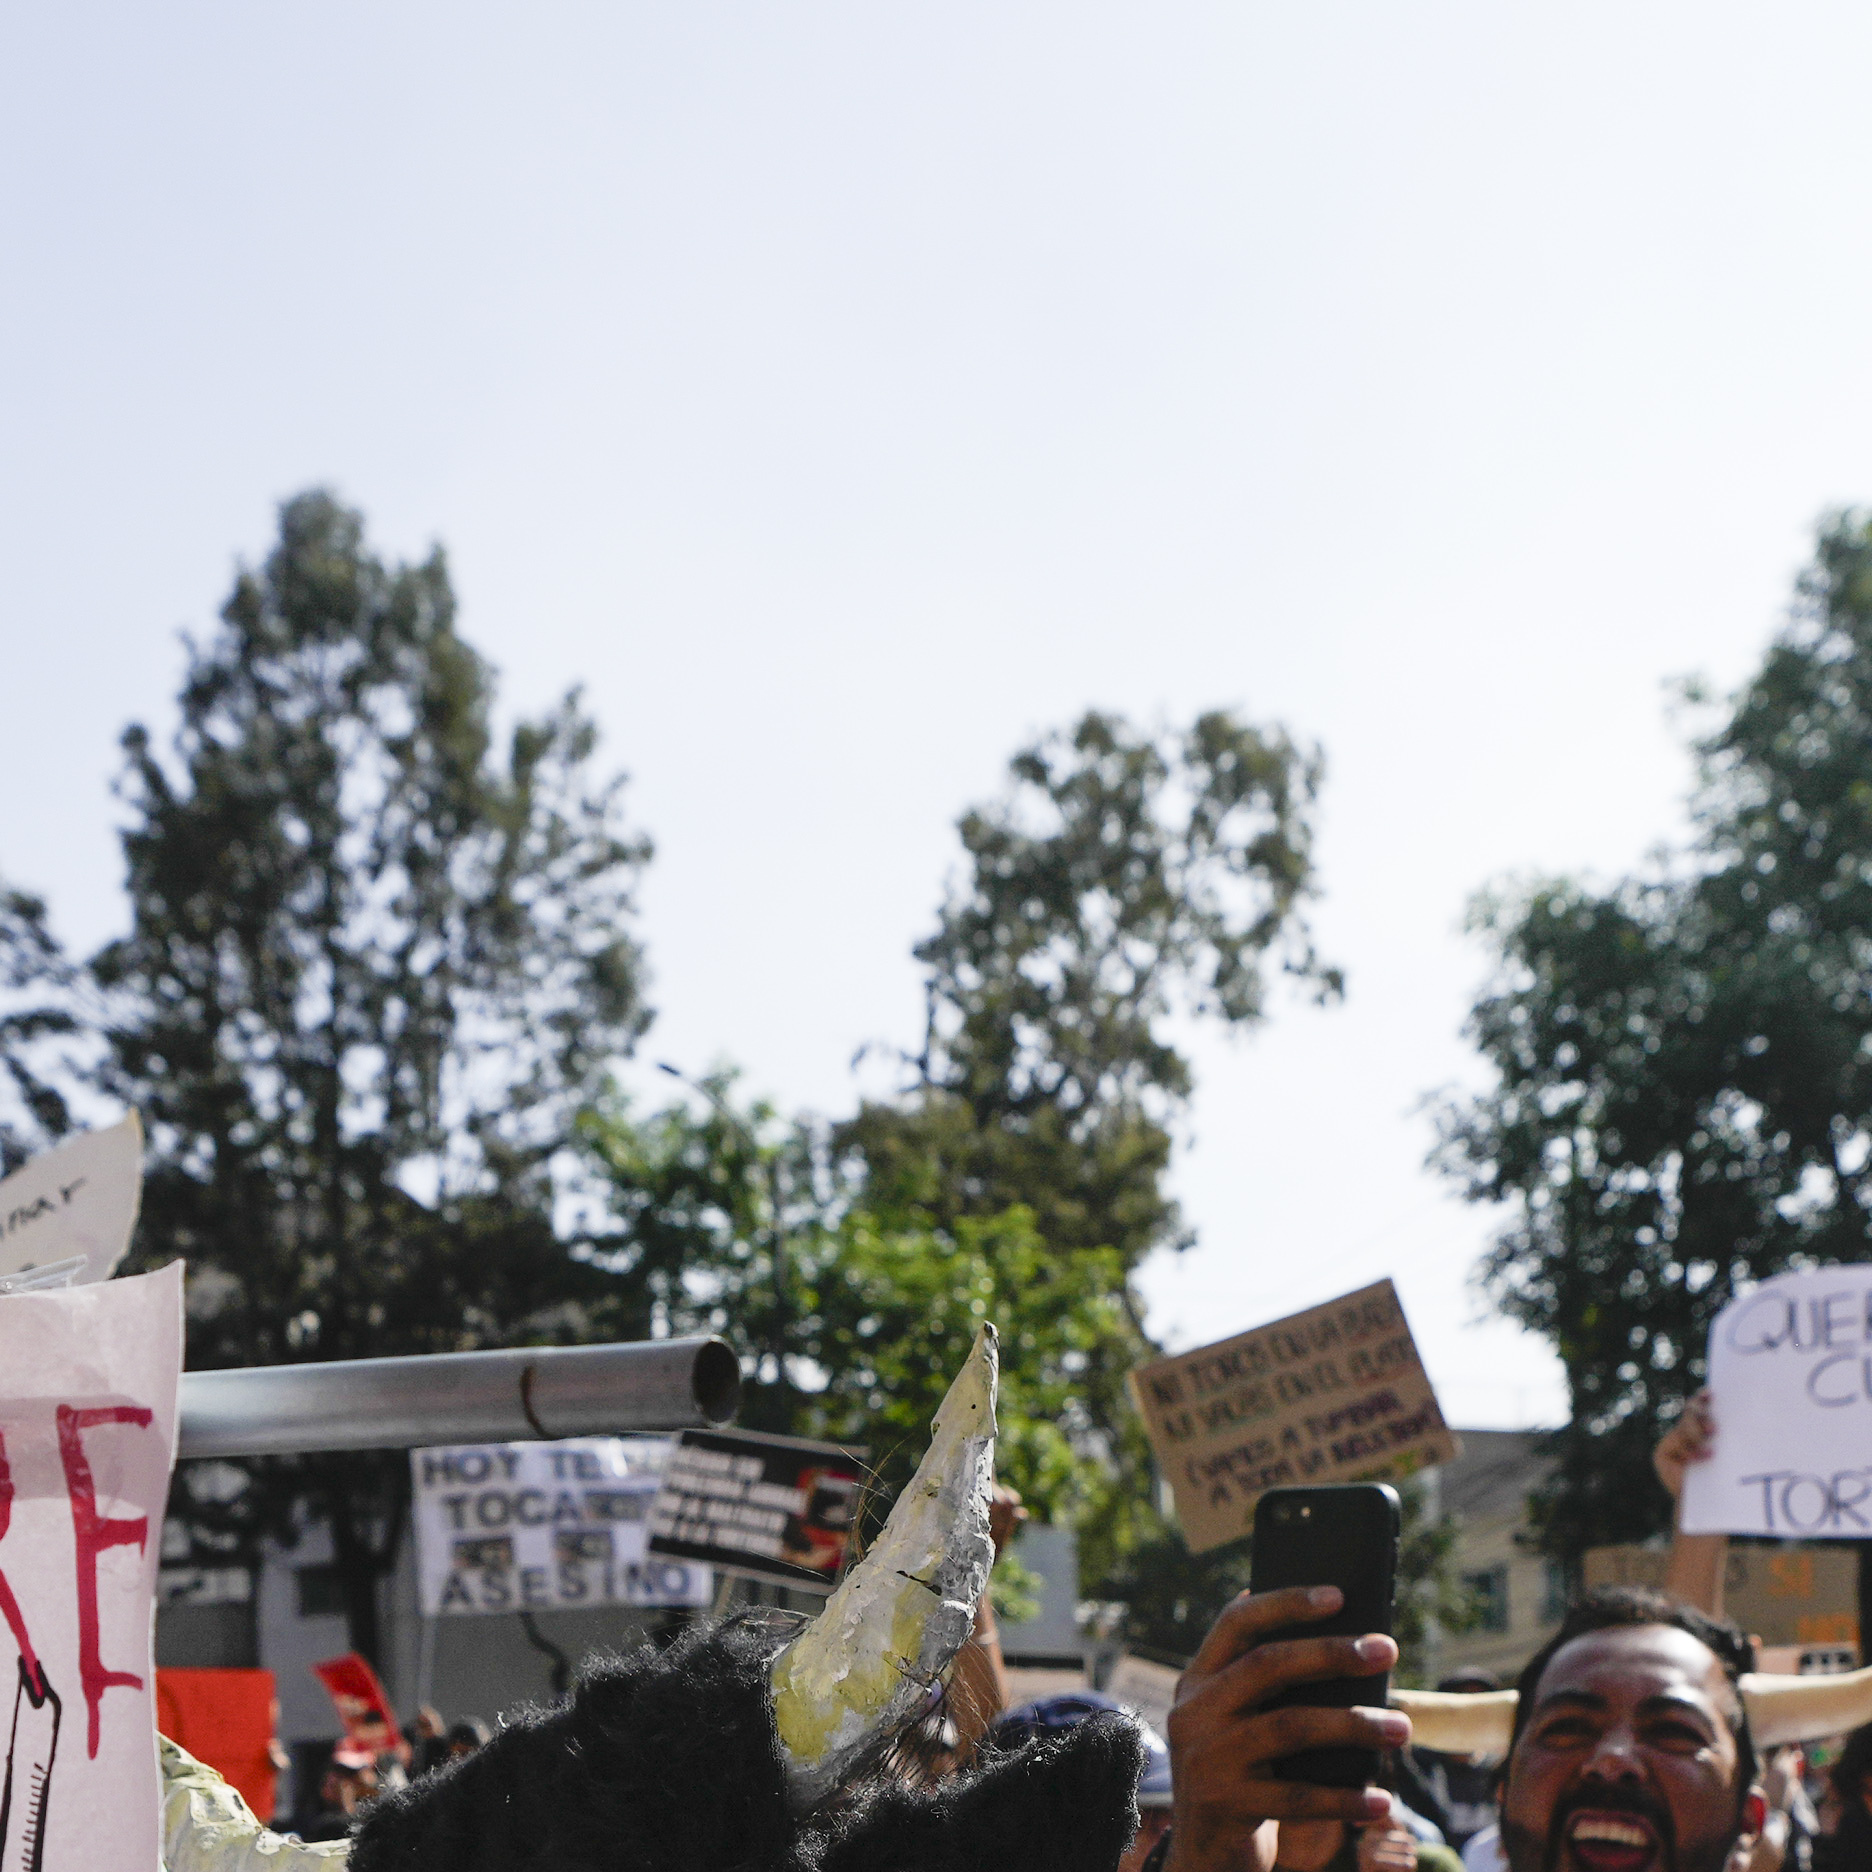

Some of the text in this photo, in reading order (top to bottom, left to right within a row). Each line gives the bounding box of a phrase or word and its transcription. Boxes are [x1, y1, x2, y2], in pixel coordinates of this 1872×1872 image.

[422, 1448, 520, 1487] HOY
[440, 1489, 582, 1529] TOCA
[440, 1561, 691, 1608] ASESINO
